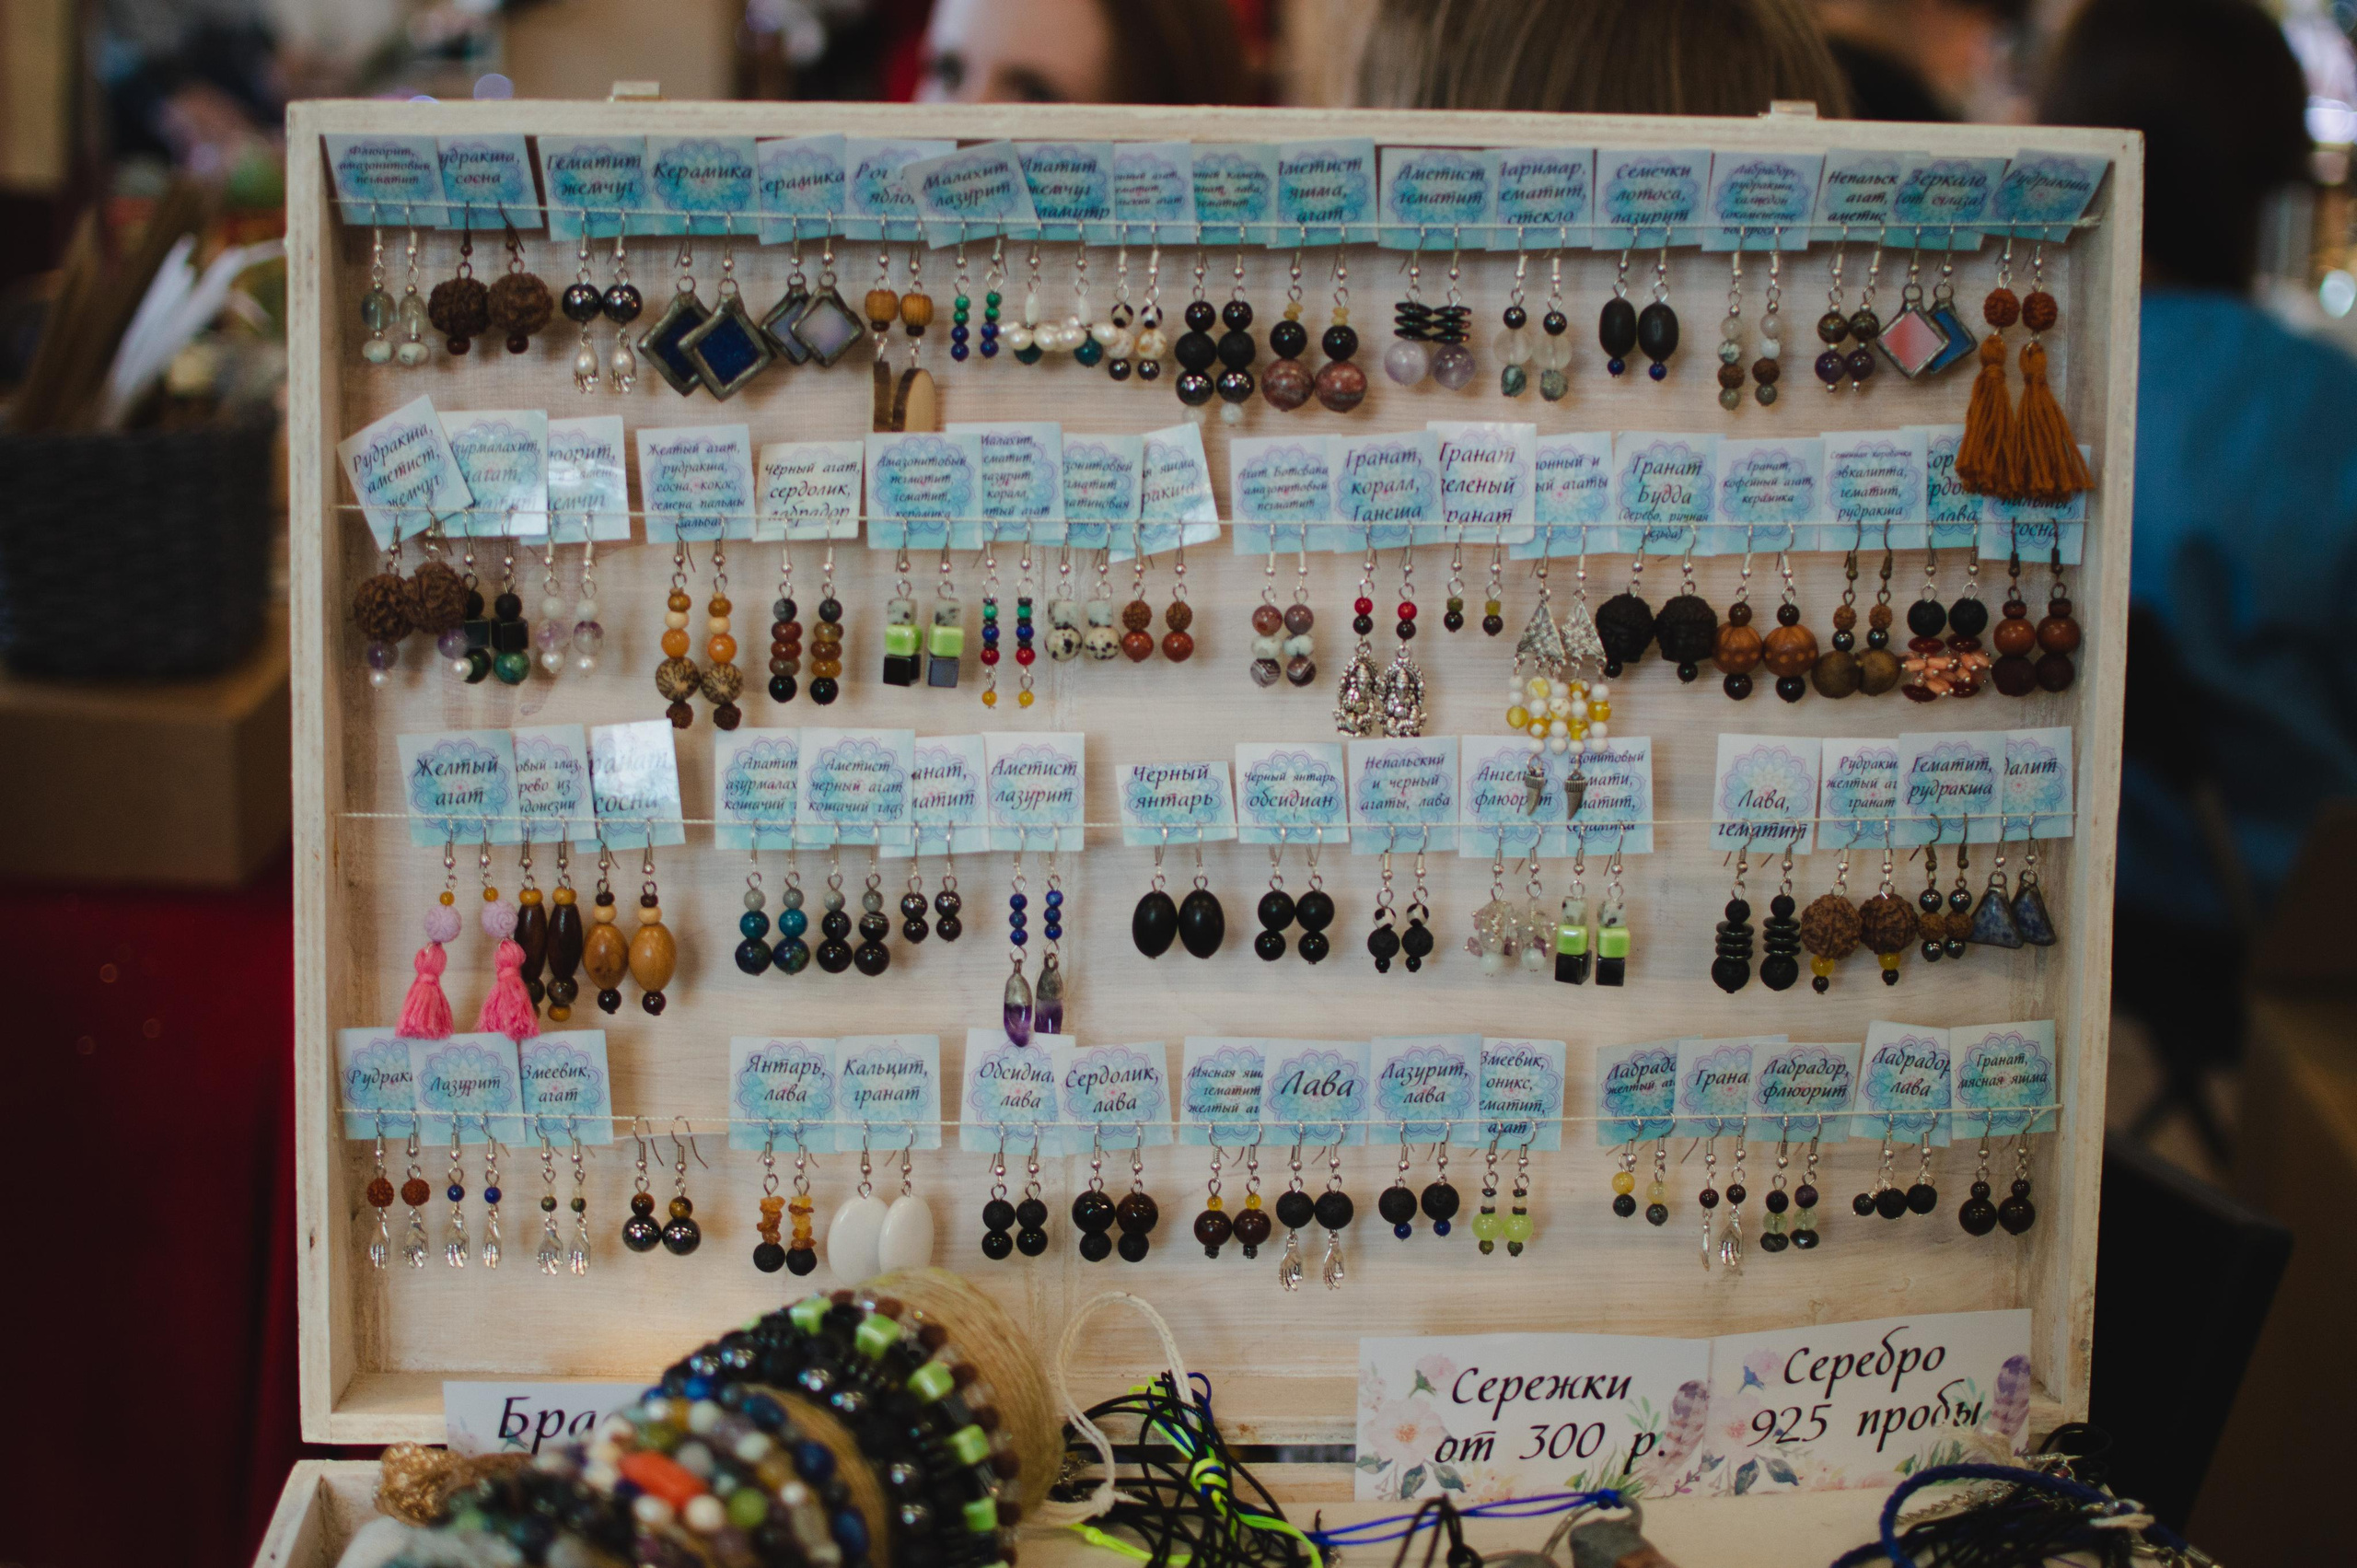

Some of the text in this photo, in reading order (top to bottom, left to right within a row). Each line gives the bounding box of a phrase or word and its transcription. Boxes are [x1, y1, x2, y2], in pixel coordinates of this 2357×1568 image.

[438, 147, 520, 169] удракша,
[547, 155, 642, 171] Гематит
[455, 173, 501, 185] сосна
[654, 161, 753, 188] Керамика
[923, 161, 1009, 192] Малахит
[1398, 164, 1486, 182] Аметист
[1617, 164, 1692, 180] Семечки
[1828, 171, 1898, 186] Непальск
[1912, 168, 1988, 196] Зеркало
[560, 180, 634, 203] жемчуг
[764, 169, 846, 200] ерамика
[1499, 185, 1586, 201] ематит,
[935, 182, 1011, 211] лазурит
[1399, 190, 1483, 205] гематит
[1615, 189, 1686, 203] лотоса,
[1845, 192, 1887, 205] агат,
[1296, 207, 1344, 224] агат
[1506, 211, 1574, 225] стекло
[1609, 211, 1689, 226] лазурит
[1828, 213, 1887, 225] аметис
[354, 424, 434, 475] Рудракша,
[647, 442, 740, 457] Желтый агат,
[1439, 442, 1516, 472] Гранат
[368, 449, 441, 495] аметист,
[661, 460, 728, 480] рудракша,
[822, 462, 860, 474] агат,
[877, 456, 967, 471] Амазонитовый
[1346, 447, 1422, 477] Гранат,
[1591, 456, 1601, 468] и
[1632, 456, 1703, 484] Гранат
[1747, 460, 1792, 473] Гранат,
[1562, 476, 1608, 489] агаты
[1835, 465, 1908, 480] эвкалипта,
[656, 479, 737, 494] сосна, кокос,
[770, 480, 851, 505] сердолик,
[1352, 476, 1420, 504] коралл,
[1723, 475, 1813, 494] кофейный агат,
[1840, 484, 1902, 499] гематит,
[652, 497, 746, 511] семена пальмы
[987, 490, 1029, 505] коралл,
[1637, 484, 1692, 513] Будда
[1741, 492, 1795, 507] керамика
[1021, 505, 1051, 517] агат
[1353, 505, 1423, 523] Ганеша
[1446, 507, 1515, 534] ранат
[1836, 503, 1904, 522] рудракша
[1935, 503, 1978, 523] лава
[414, 757, 499, 778] Желтый
[554, 759, 583, 774] глаз,
[825, 759, 891, 773] Аметист
[991, 759, 1079, 777] Аметист
[1364, 752, 1446, 771] Непальский
[1839, 755, 1898, 776] Рудракш
[1910, 756, 1992, 775] Гематит,
[1133, 762, 1210, 790] Черный
[1244, 769, 1337, 787] Черный янтарь
[1372, 773, 1440, 796] и черный
[1825, 777, 1879, 789] желтый
[517, 777, 572, 800] рево из
[726, 778, 797, 796] азурмалах
[811, 780, 902, 797] черный агат
[1249, 785, 1334, 808] обсидиан
[1906, 779, 1993, 807] рудракша
[435, 788, 485, 807] агат
[724, 797, 785, 811] кошачий
[994, 788, 1074, 811] лазурит
[1135, 792, 1213, 815] янтарь
[1361, 792, 1451, 812] агаты, лава
[1475, 788, 1553, 814] флюорт
[1736, 788, 1791, 814] Лава,
[1848, 796, 1897, 816] гранат
[808, 797, 869, 812] кошачий
[877, 799, 904, 819] глаз
[1717, 822, 1808, 840] гематит
[746, 1053, 827, 1084] Янтарь,
[842, 1058, 929, 1080] Кальцит,
[979, 1056, 1055, 1085] Обсидиа
[1480, 1051, 1545, 1071] Змеевик,
[1607, 1056, 1677, 1086] Лабрадо
[1762, 1054, 1850, 1084] Лабрадор,
[1976, 1051, 2029, 1074] Гранат,
[349, 1067, 413, 1093] Рудрак
[521, 1063, 592, 1081] Змеевик,
[1065, 1064, 1159, 1096] Сердолик,
[1187, 1066, 1236, 1079] Мясная
[1381, 1062, 1469, 1089] Лазурит,
[1695, 1069, 1751, 1094] Грана
[1957, 1073, 2049, 1090] мясная яшма
[429, 1075, 503, 1098] Лазурит
[539, 1086, 580, 1103] агат
[763, 1084, 808, 1104] лава
[1202, 1085, 1262, 1097] гематит
[1280, 1069, 1355, 1100] Лава
[1485, 1077, 1533, 1092] оникс,
[1606, 1079, 1655, 1095] желтый
[1762, 1080, 1849, 1106] флюорит
[1889, 1077, 1933, 1098] лава
[854, 1086, 922, 1110] гранат
[1000, 1090, 1042, 1109] лава
[1093, 1092, 1138, 1114] лава
[1402, 1086, 1446, 1105] лава
[1188, 1102, 1240, 1115] желтый
[1479, 1098, 1546, 1115] ематит,
[1783, 1326, 1946, 1400] Серебро
[1451, 1366, 1633, 1422] Сережки
[1746, 1378, 1983, 1454] 925 пробы
[1434, 1422, 1666, 1476] от 300 р.
